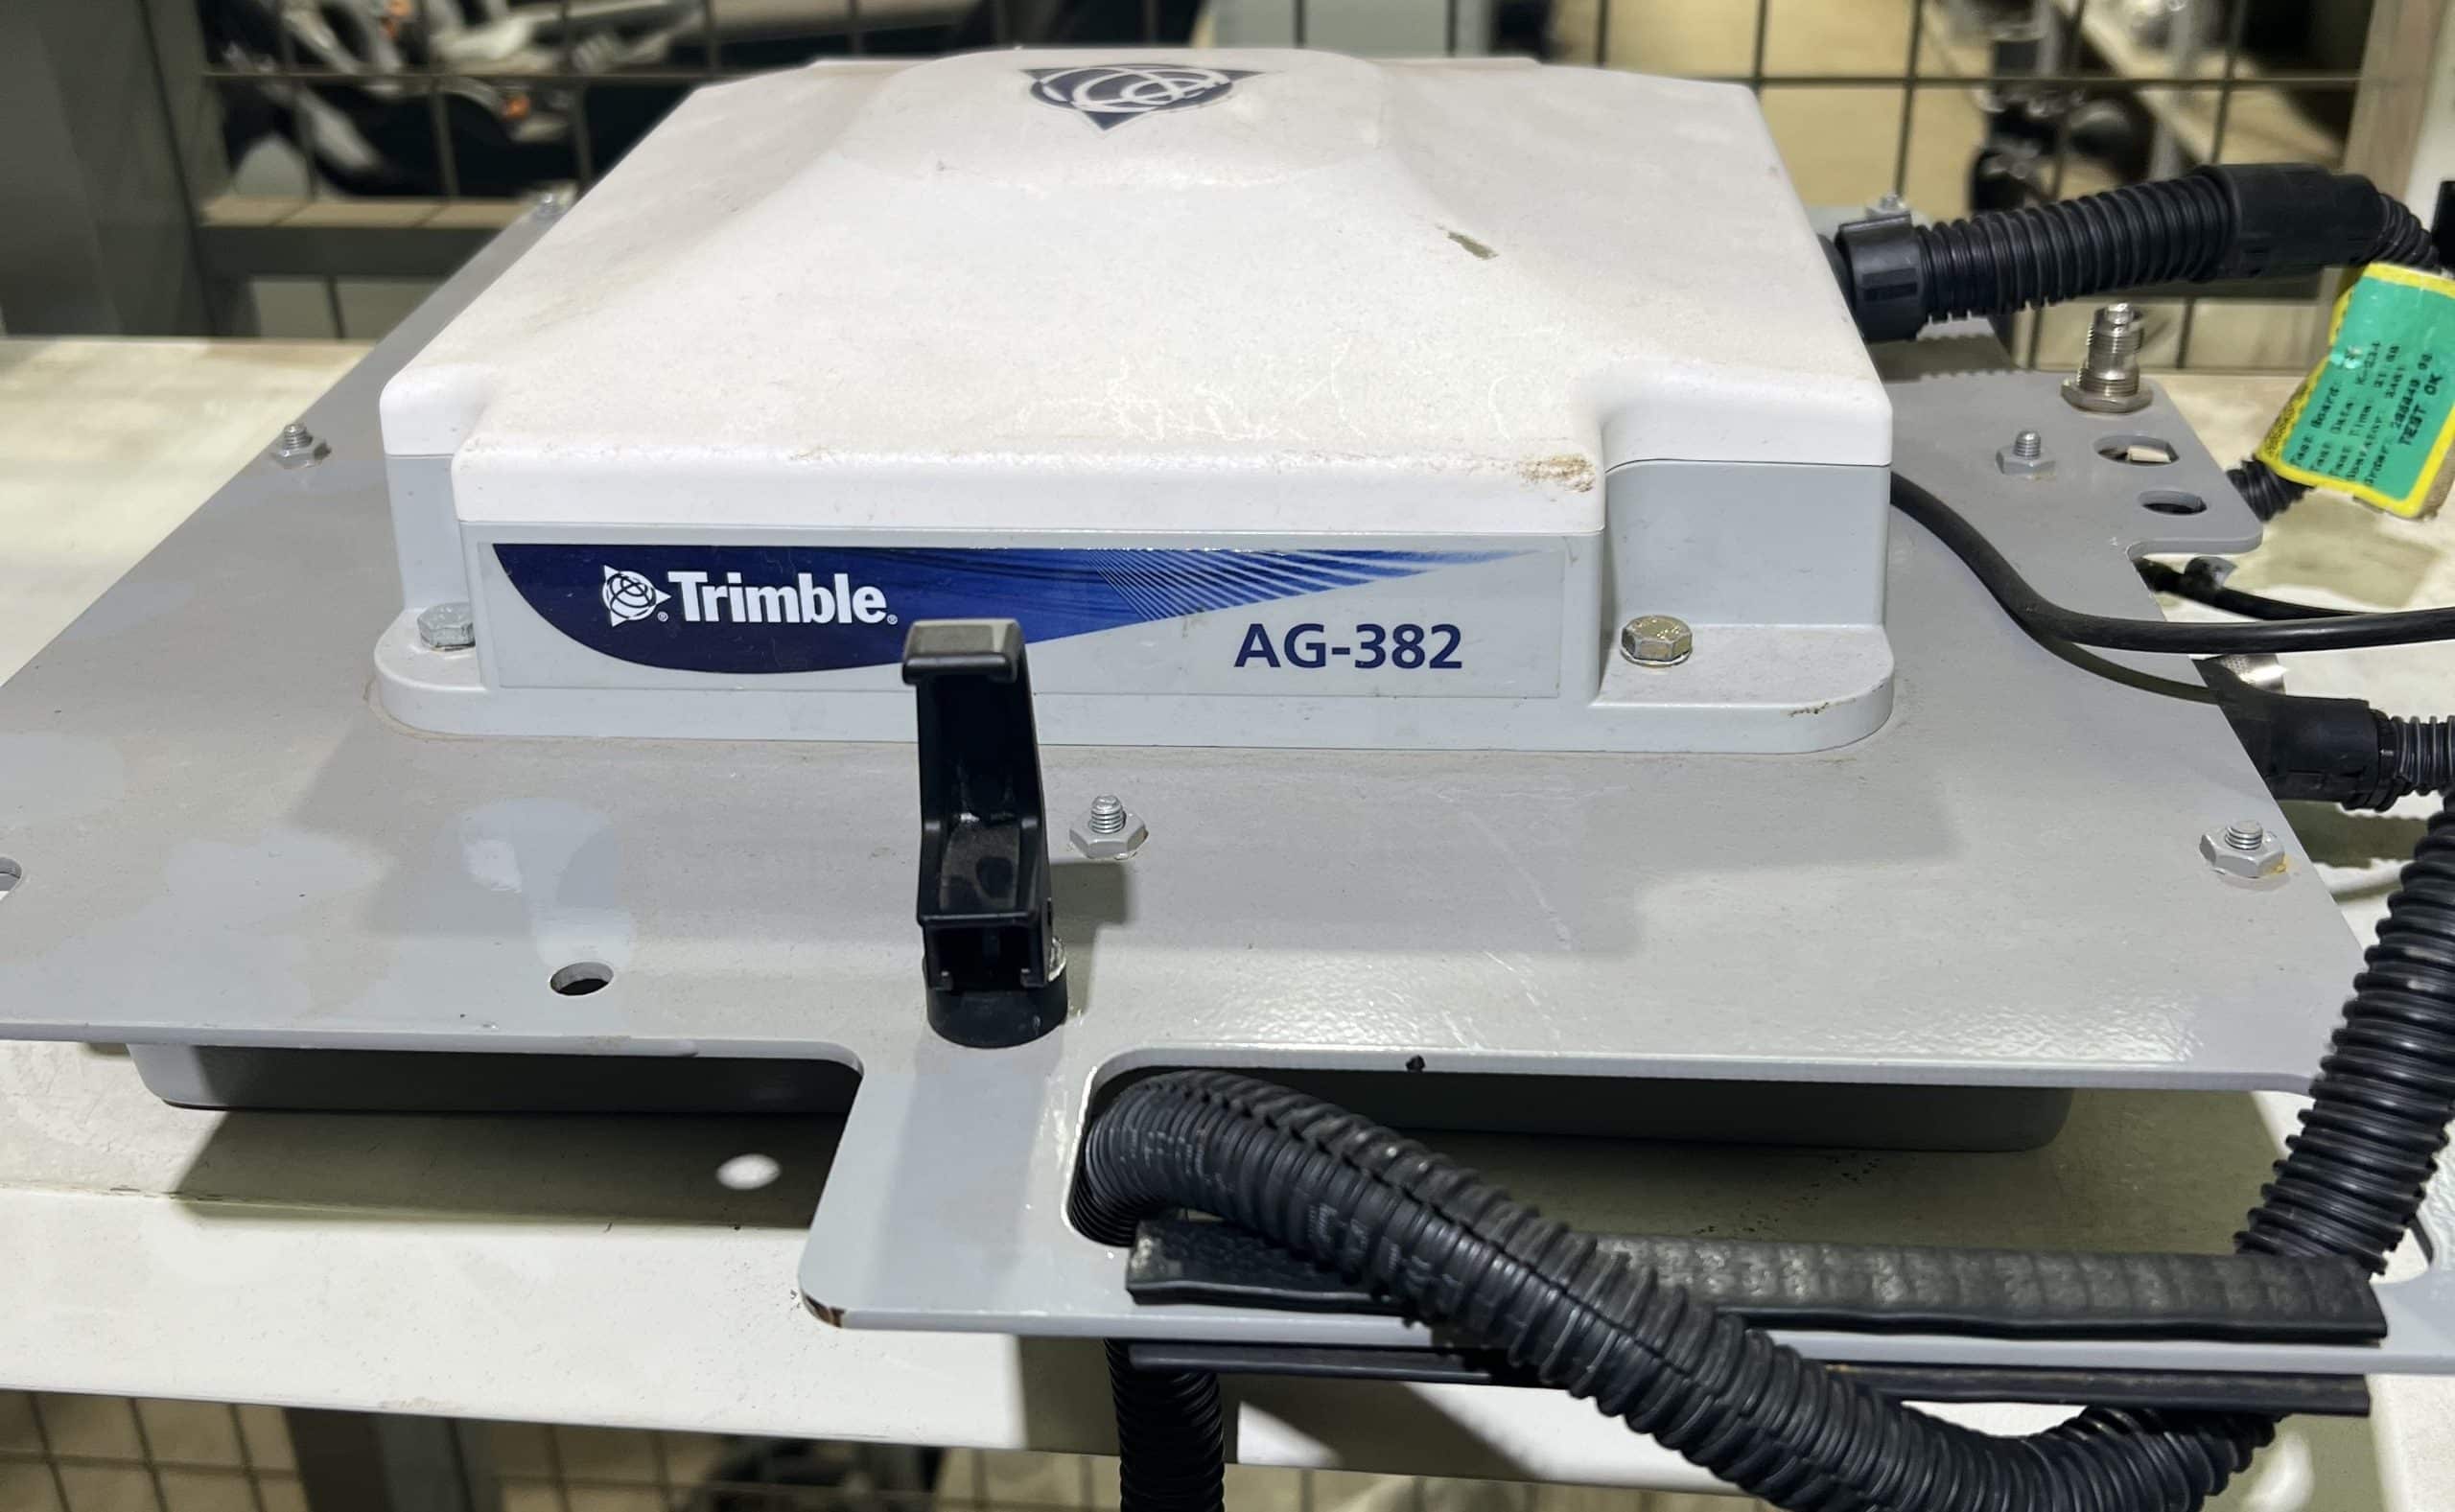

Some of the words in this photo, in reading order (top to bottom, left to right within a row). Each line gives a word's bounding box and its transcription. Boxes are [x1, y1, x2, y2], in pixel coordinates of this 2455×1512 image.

[2398, 403, 2427, 446] TEST
[2424, 372, 2444, 396] OK
[667, 570, 887, 624] Trimble
[1234, 622, 1462, 669] AG-382
